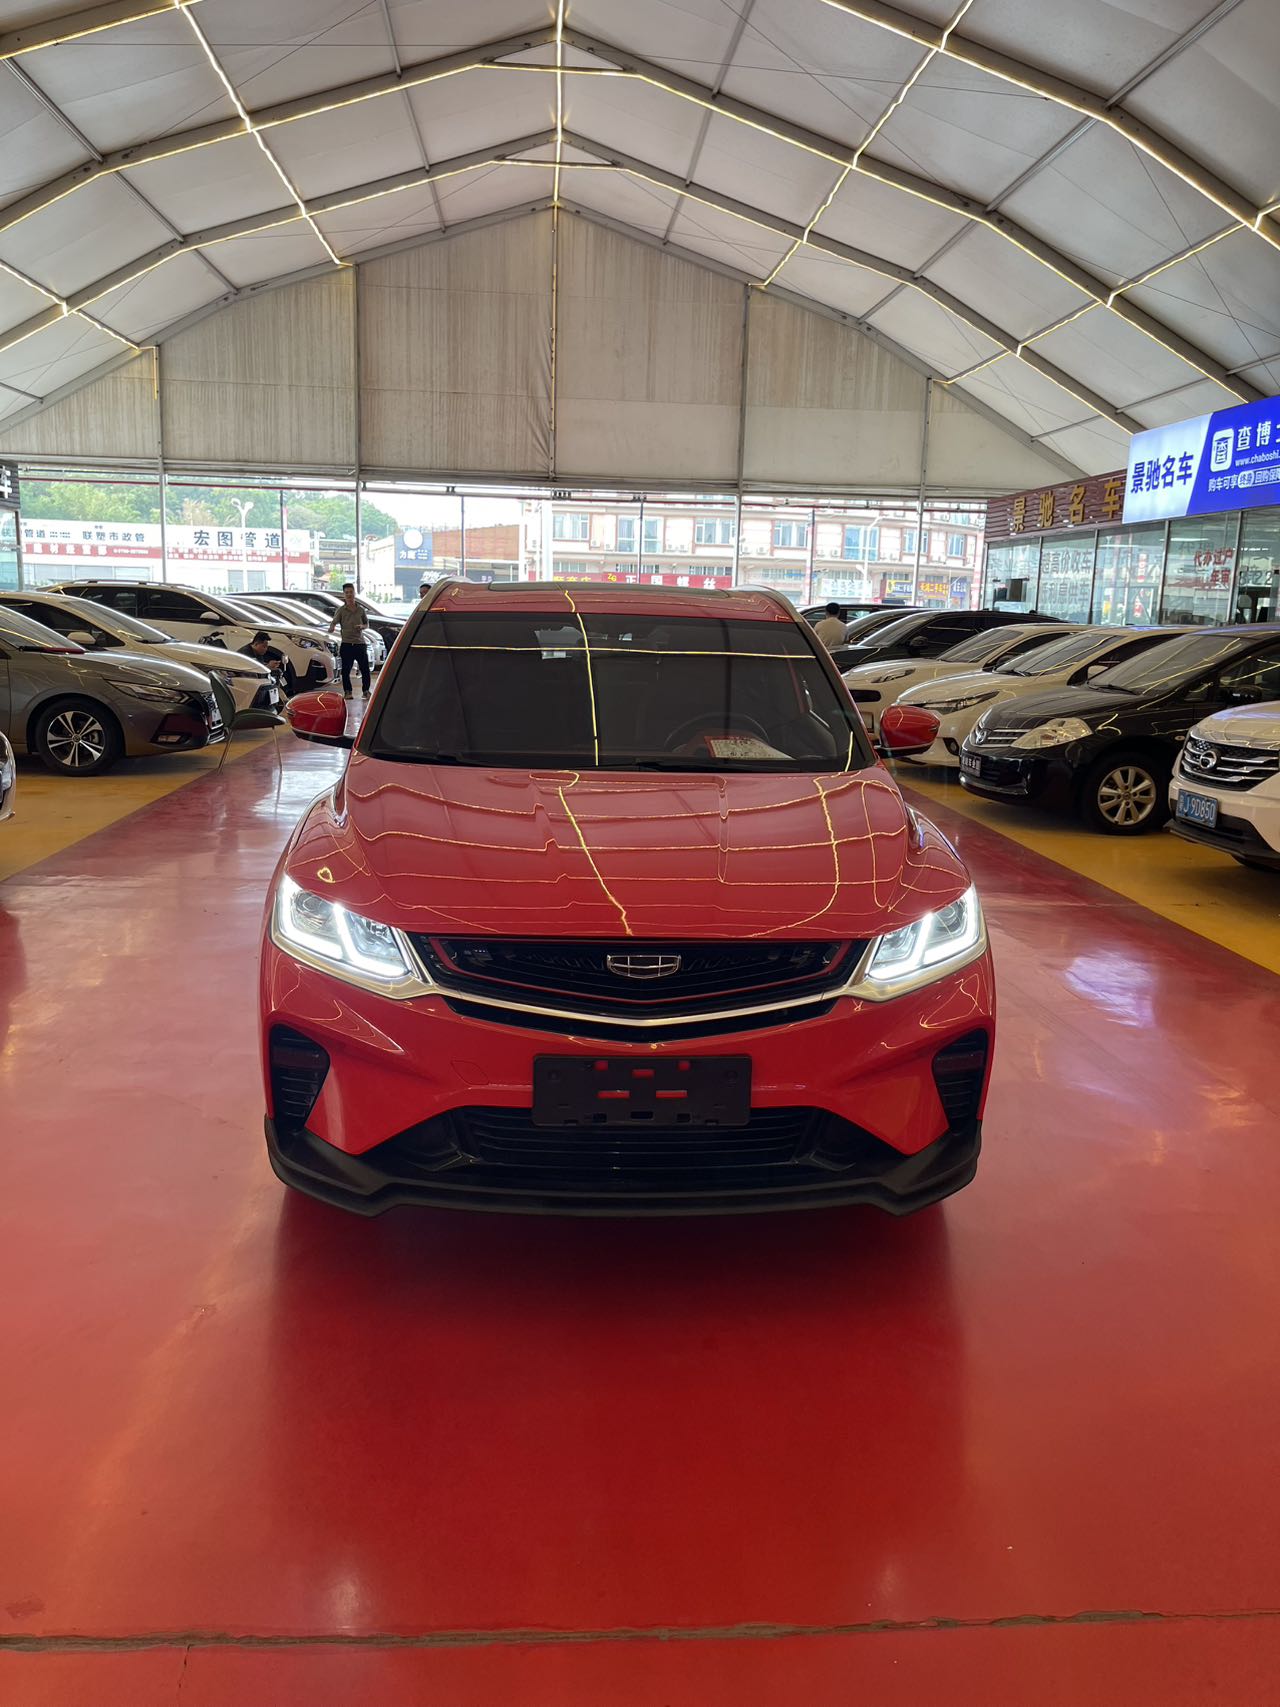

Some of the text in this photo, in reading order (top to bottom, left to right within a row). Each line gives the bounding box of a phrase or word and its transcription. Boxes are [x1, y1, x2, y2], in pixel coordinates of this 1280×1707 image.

[1236, 421, 1280, 451] 查博
[1131, 451, 1194, 493] 景驰名车
[1013, 477, 1122, 532] 景驰名车
[194, 530, 281, 548] 宏图管道
